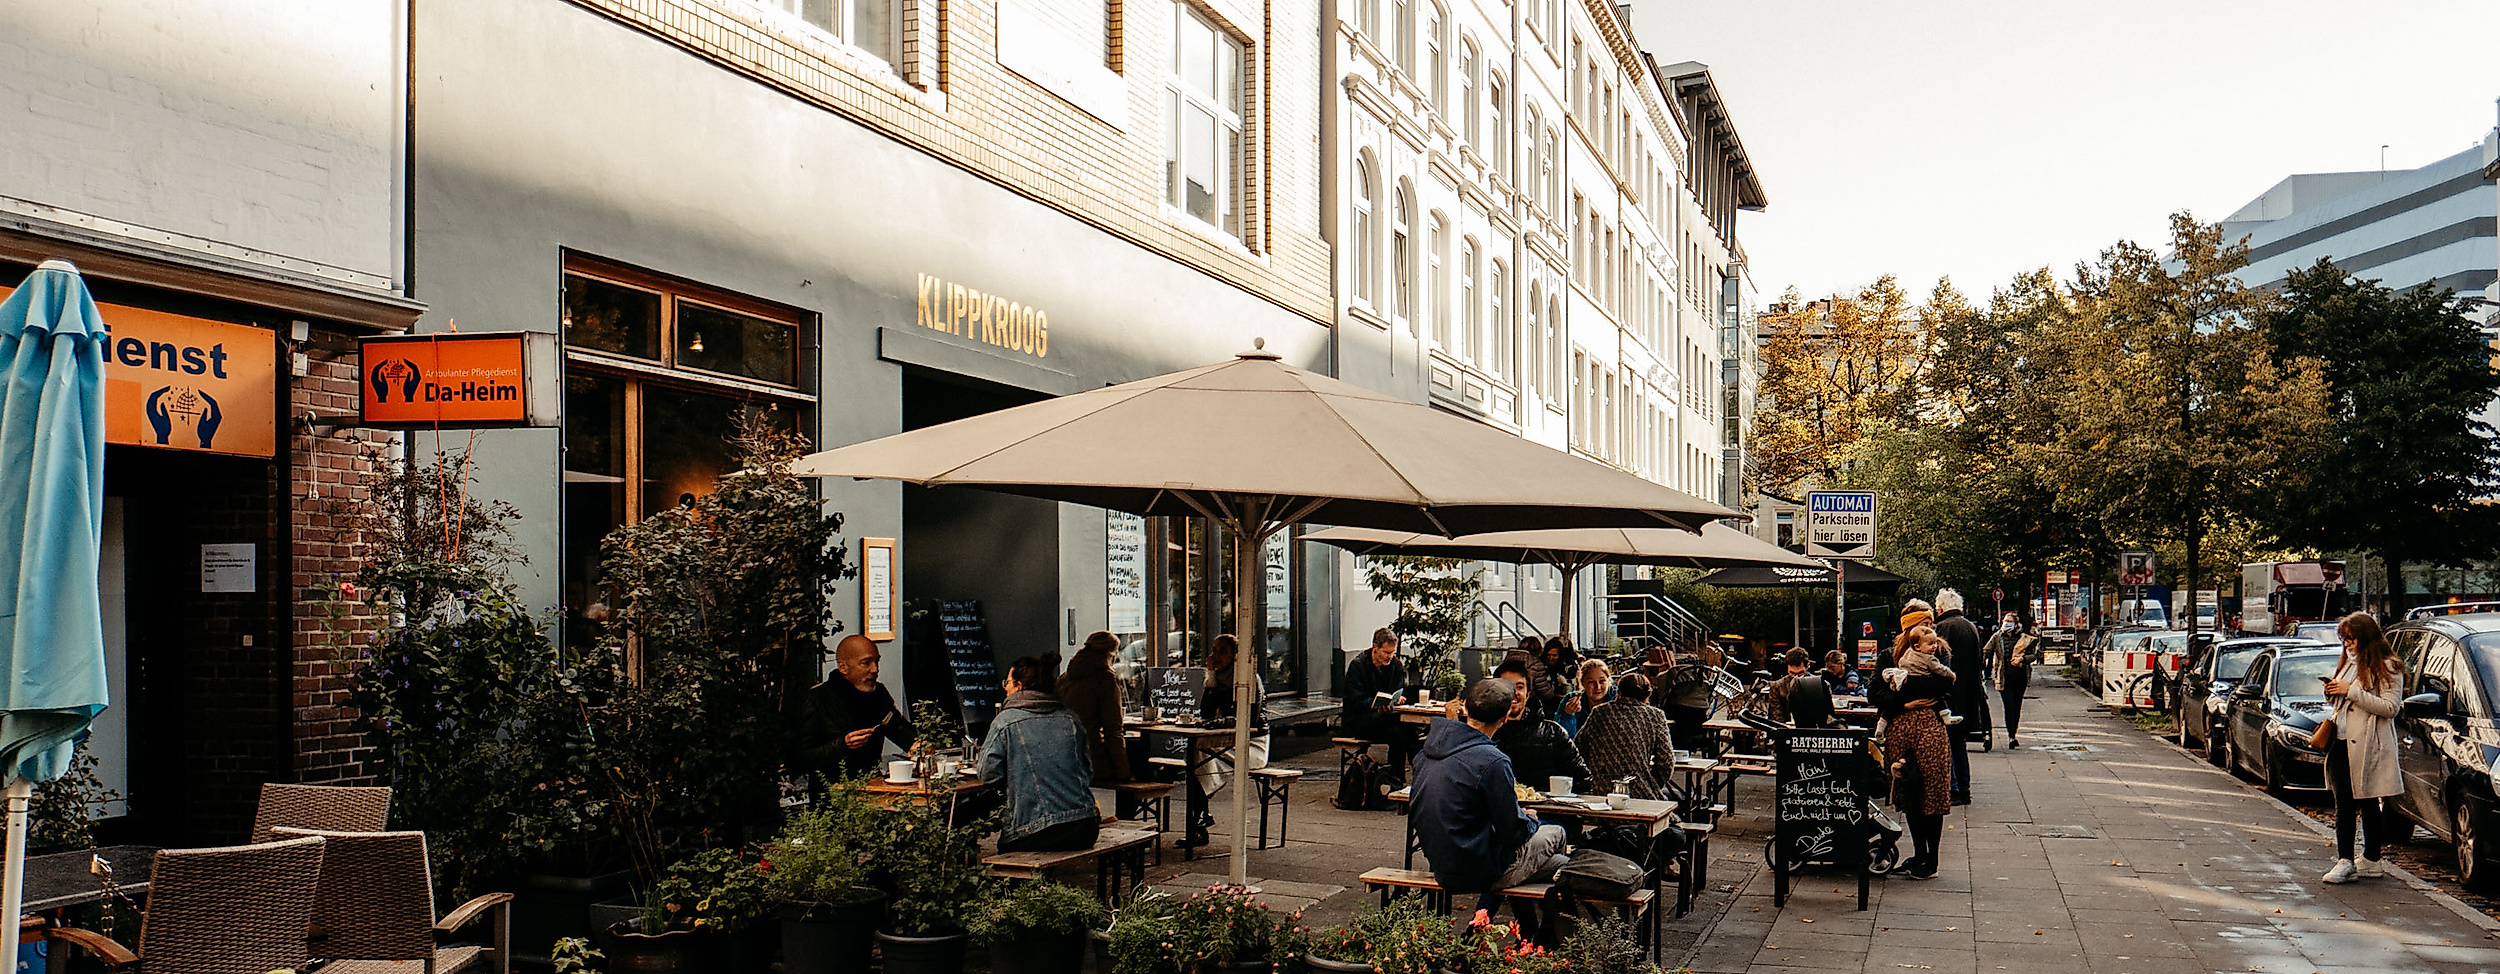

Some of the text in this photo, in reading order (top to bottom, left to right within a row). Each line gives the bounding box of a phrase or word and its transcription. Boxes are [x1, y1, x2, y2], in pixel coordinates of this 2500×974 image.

[917, 272, 1047, 358] KLIPPKROOG
[471, 368, 517, 379] Pflegedienst
[425, 380, 517, 401] Da-Heim
[1813, 496, 1871, 511] AUTOMAT
[1813, 513, 1870, 526] Parkschein
[1813, 529, 1868, 542] hier lösen
[1791, 736, 1854, 749] RATSHERRN
